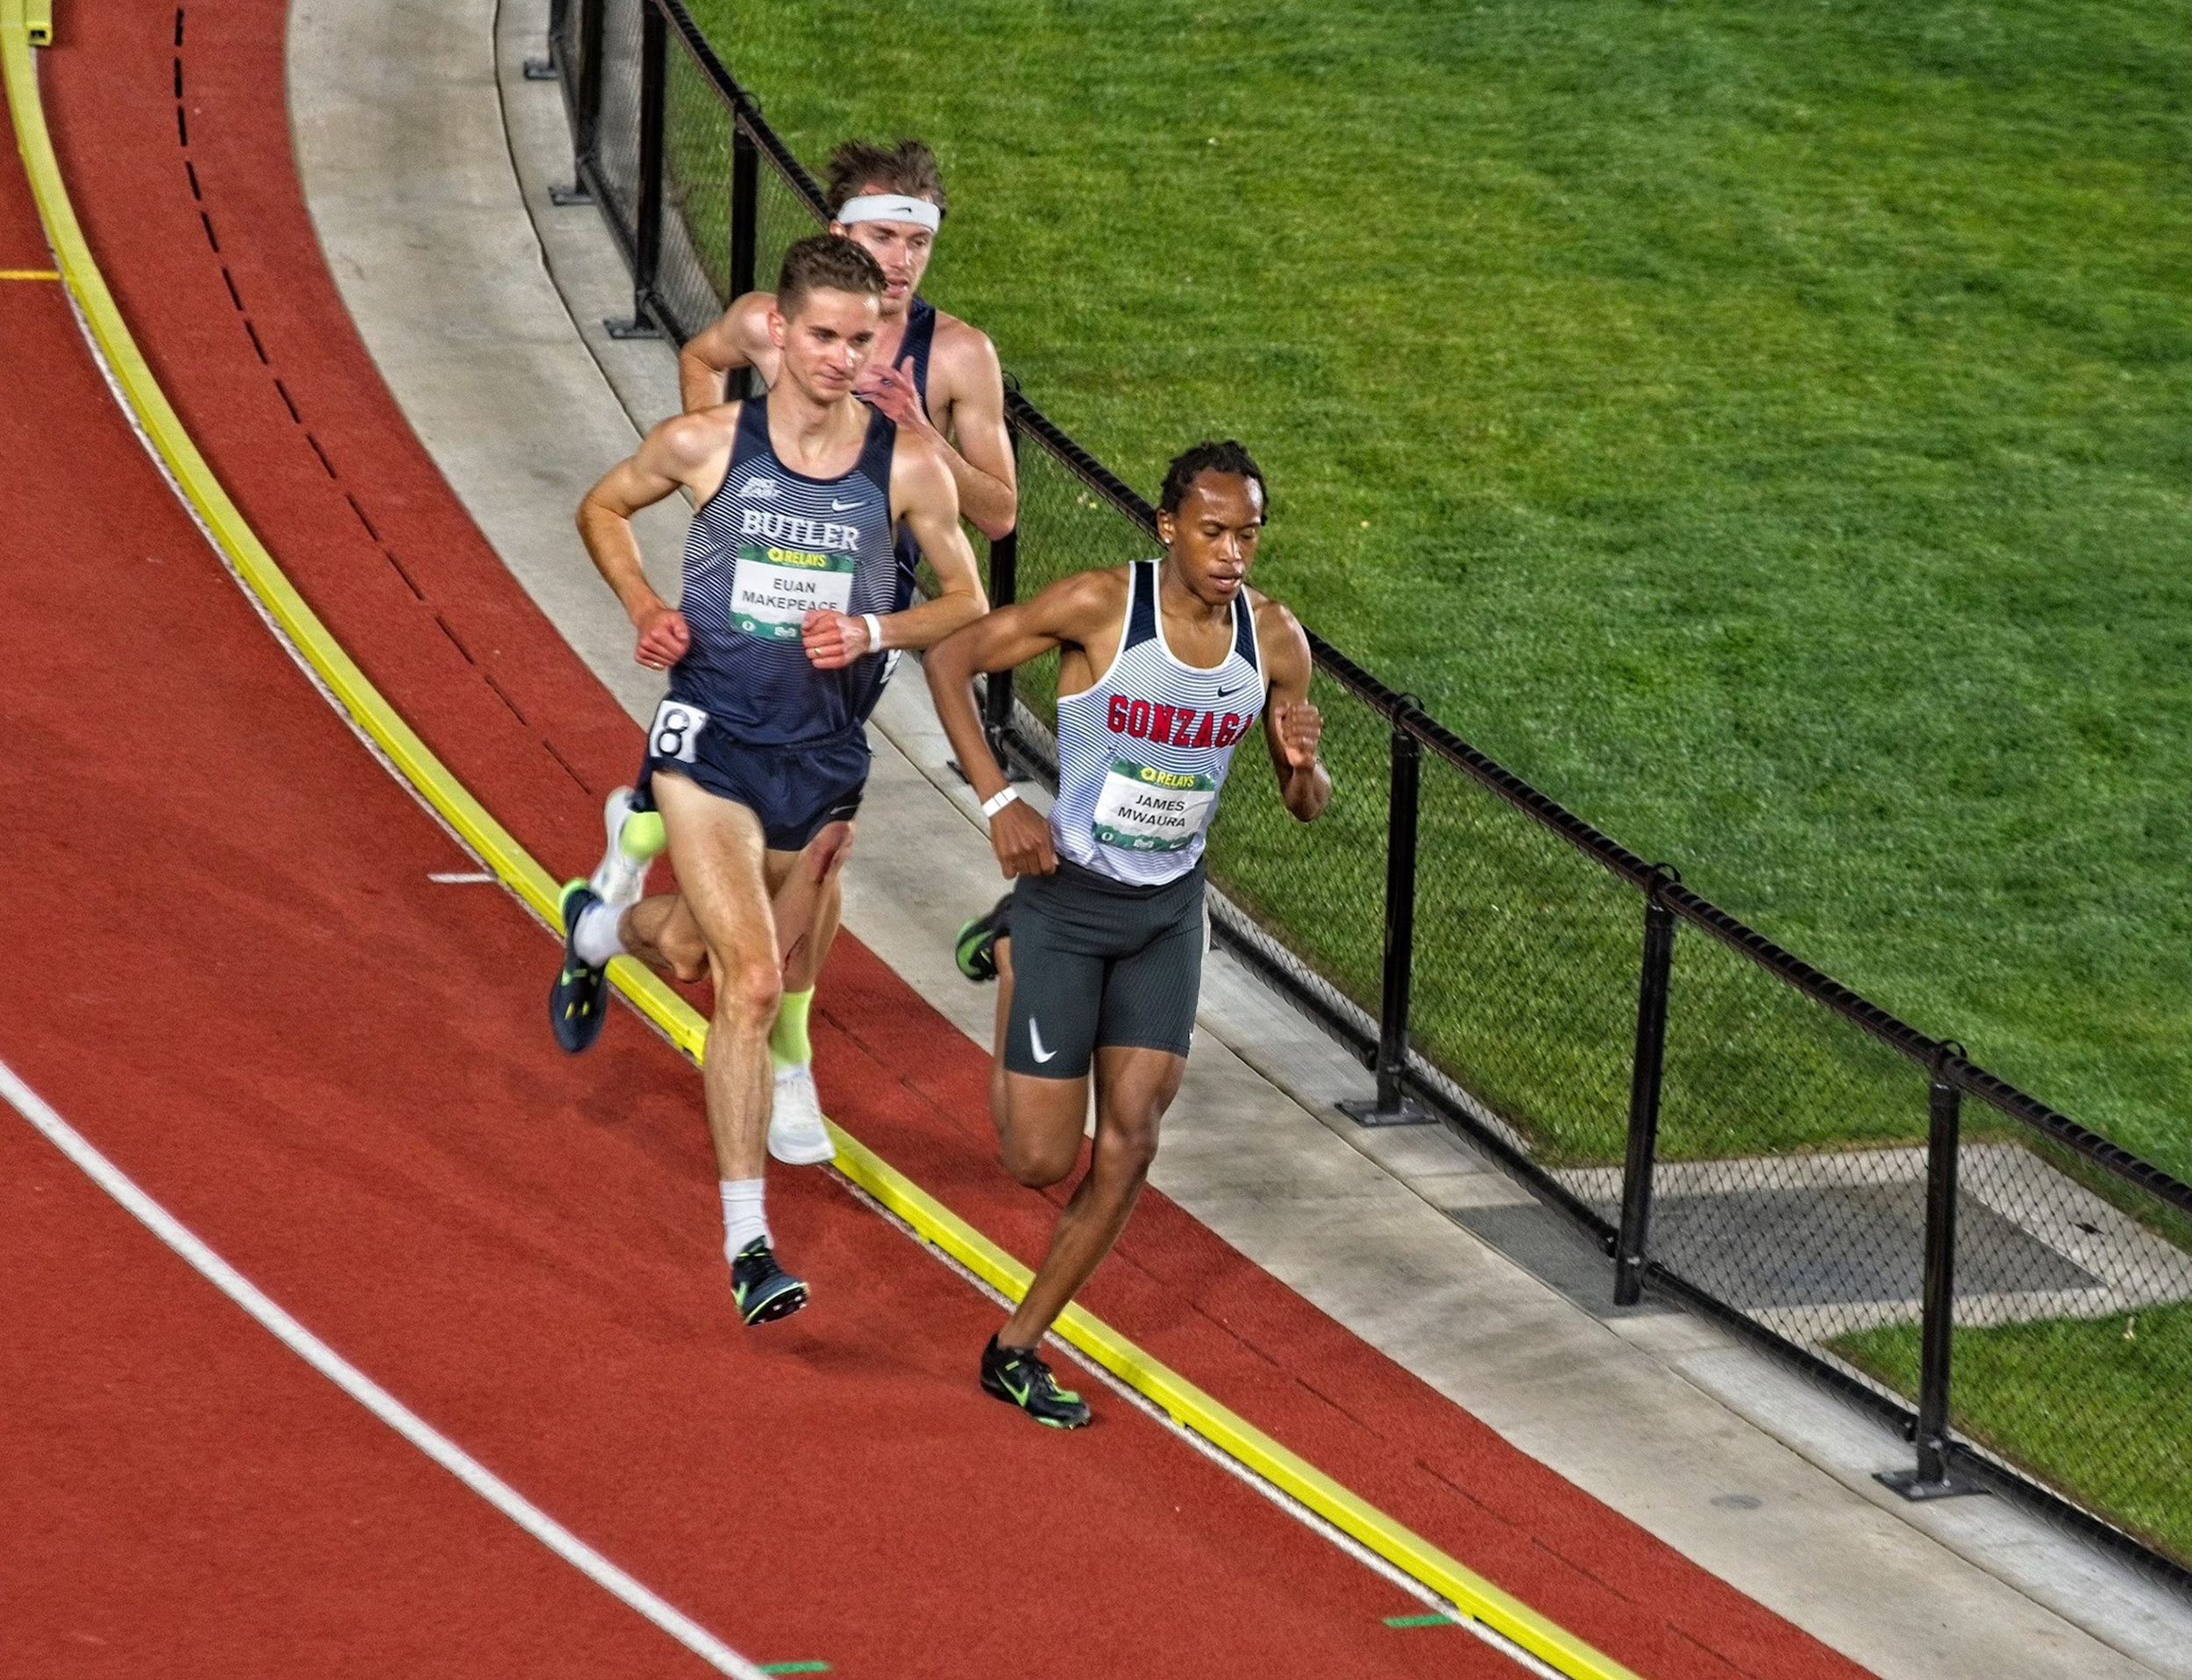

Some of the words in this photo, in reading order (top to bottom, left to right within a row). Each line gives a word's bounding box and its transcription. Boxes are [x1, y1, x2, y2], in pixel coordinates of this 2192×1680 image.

[740, 509, 859, 552] BUTLER
[785, 550, 827, 568] RELAYS
[773, 578, 815, 594] EUAN
[655, 708, 690, 758] 8
[1156, 771, 1195, 787] RELAYS
[1135, 794, 1185, 811] JAMES
[1117, 807, 1186, 827] MWAURA
